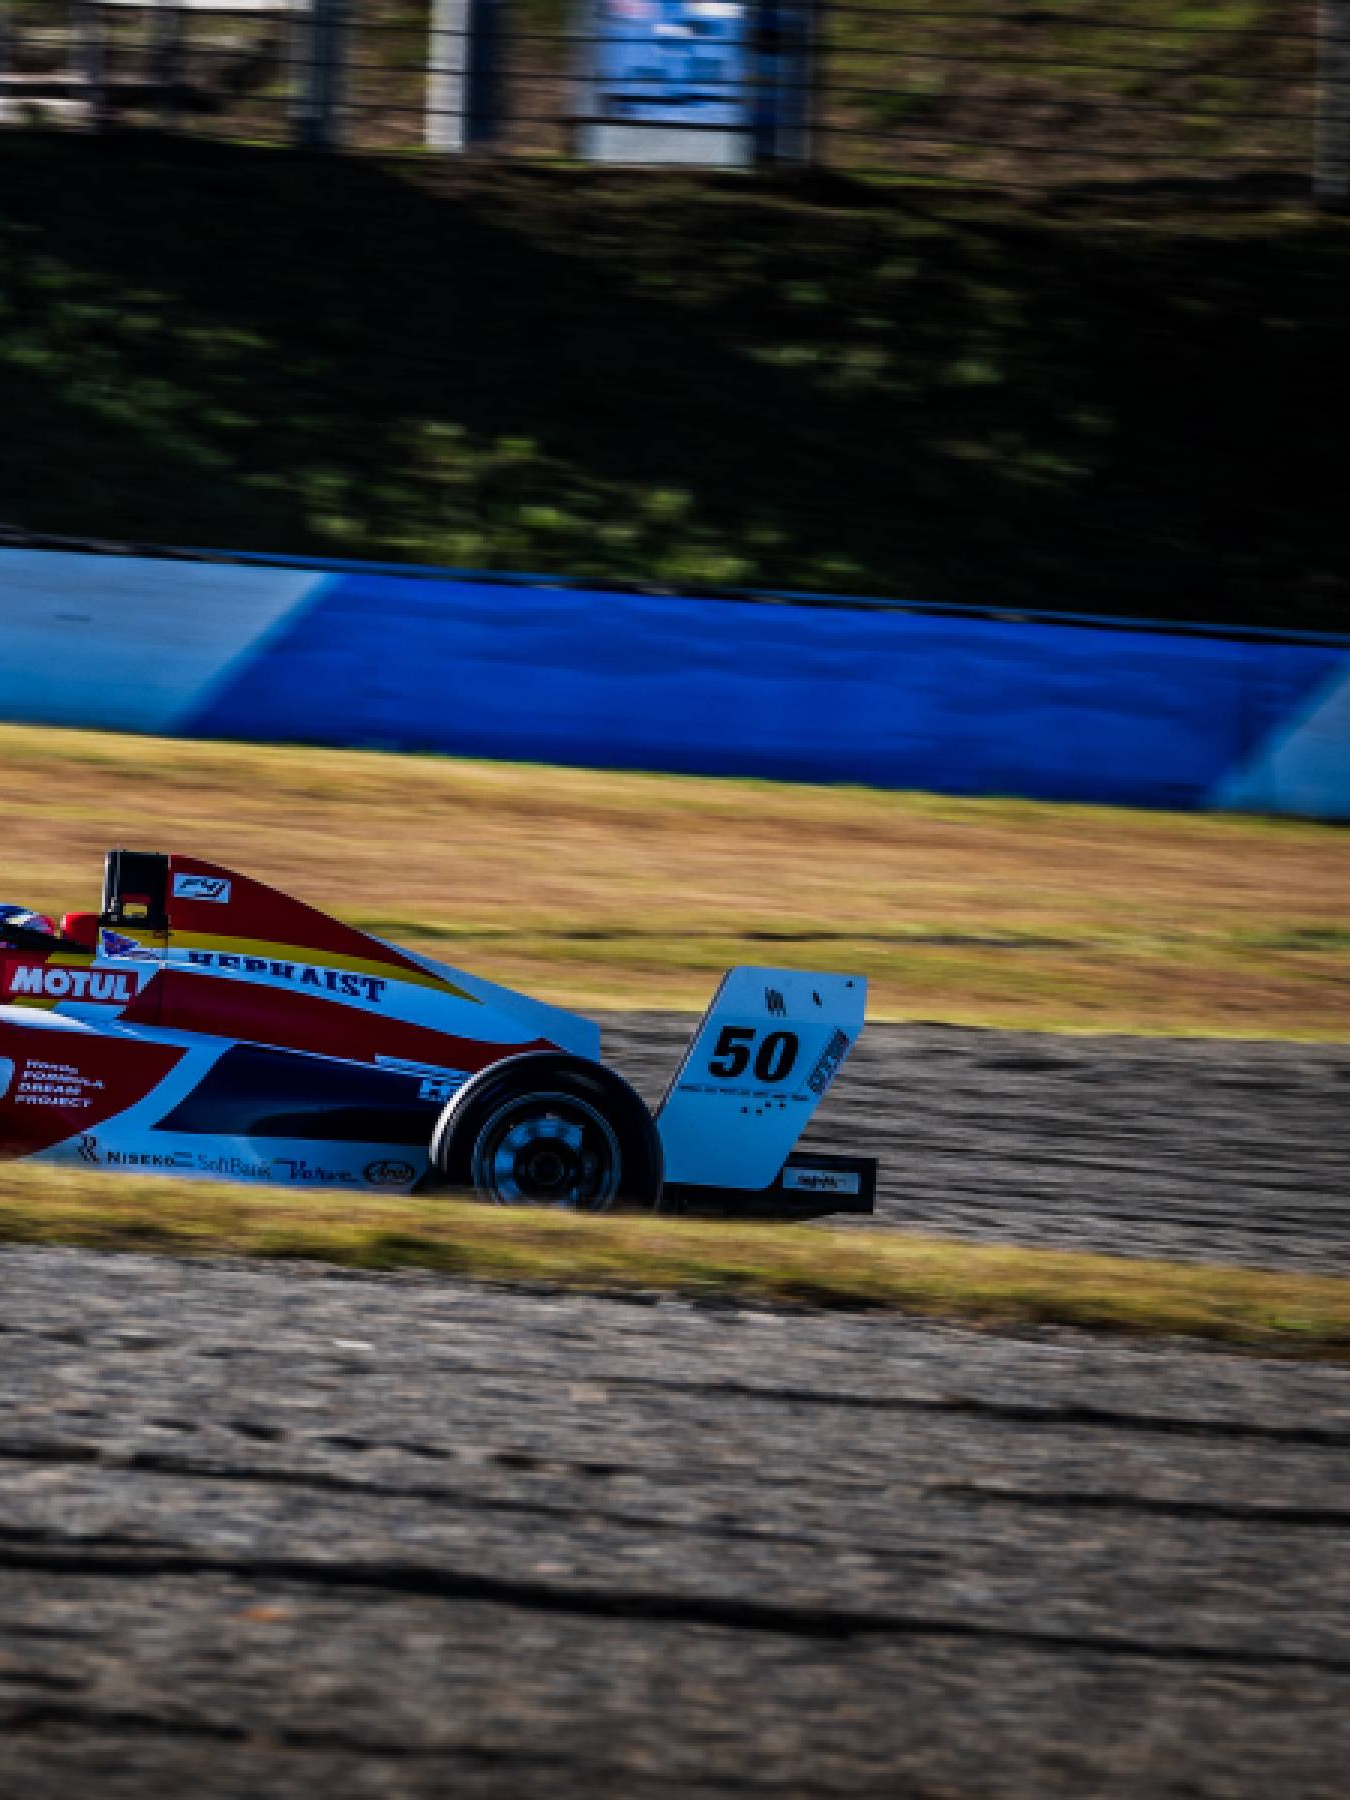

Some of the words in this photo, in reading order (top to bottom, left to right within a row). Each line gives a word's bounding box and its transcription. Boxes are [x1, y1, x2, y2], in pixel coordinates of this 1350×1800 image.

[9, 964, 132, 1001] MOTUL
[707, 1025, 800, 1084] 50
[15, 1094, 92, 1107] PROJECT
[18, 1082, 82, 1096] DREAM
[197, 1152, 272, 1177] SoftBank
